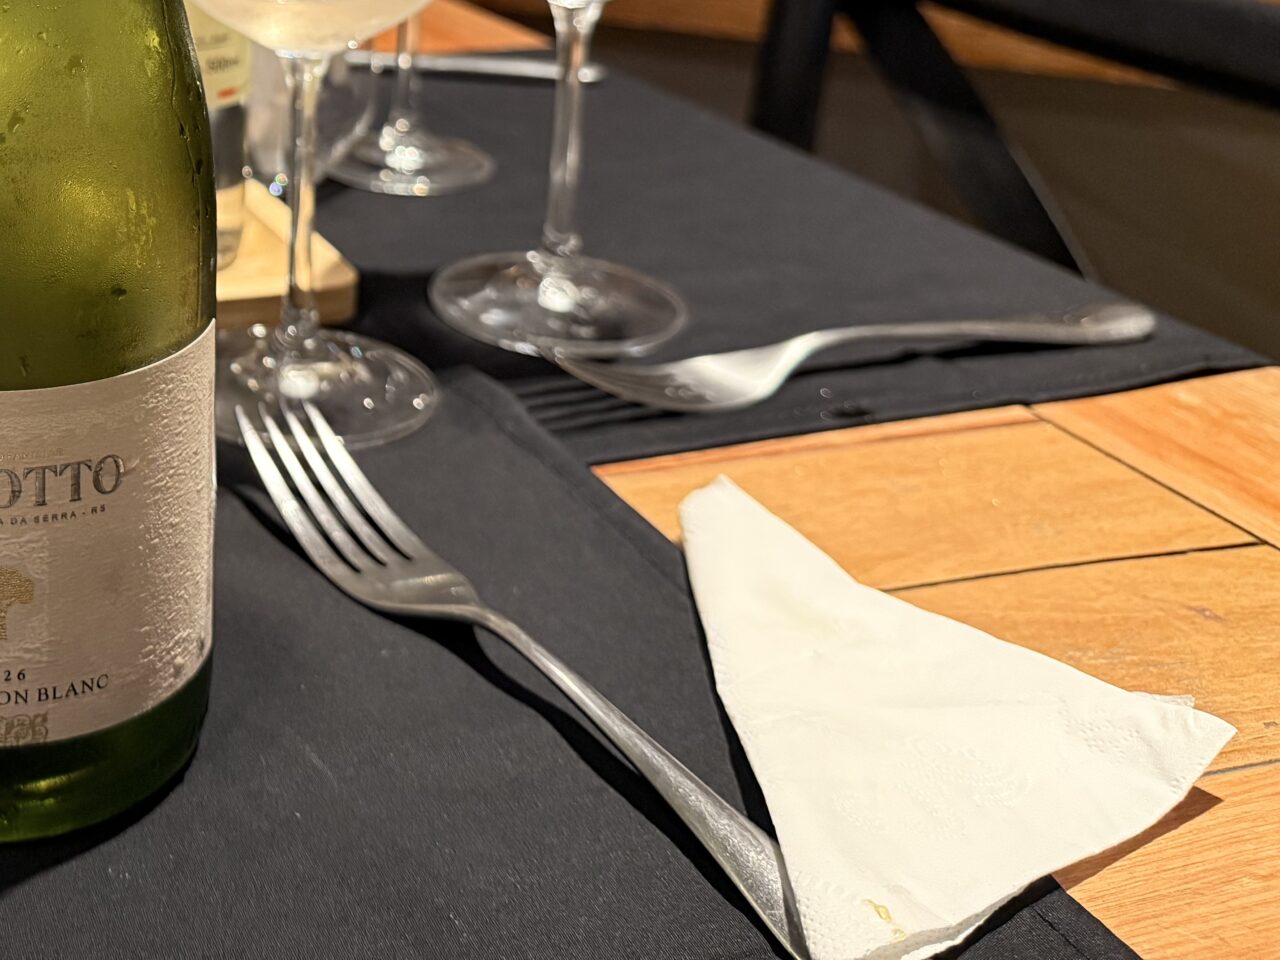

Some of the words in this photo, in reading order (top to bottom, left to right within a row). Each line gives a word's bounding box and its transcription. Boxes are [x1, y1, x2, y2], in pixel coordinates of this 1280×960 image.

[10, 516, 28, 526] DA
[33, 511, 78, 524] SERRA
[90, 504, 106, 515] RS
[36, 673, 110, 702] BLANC
